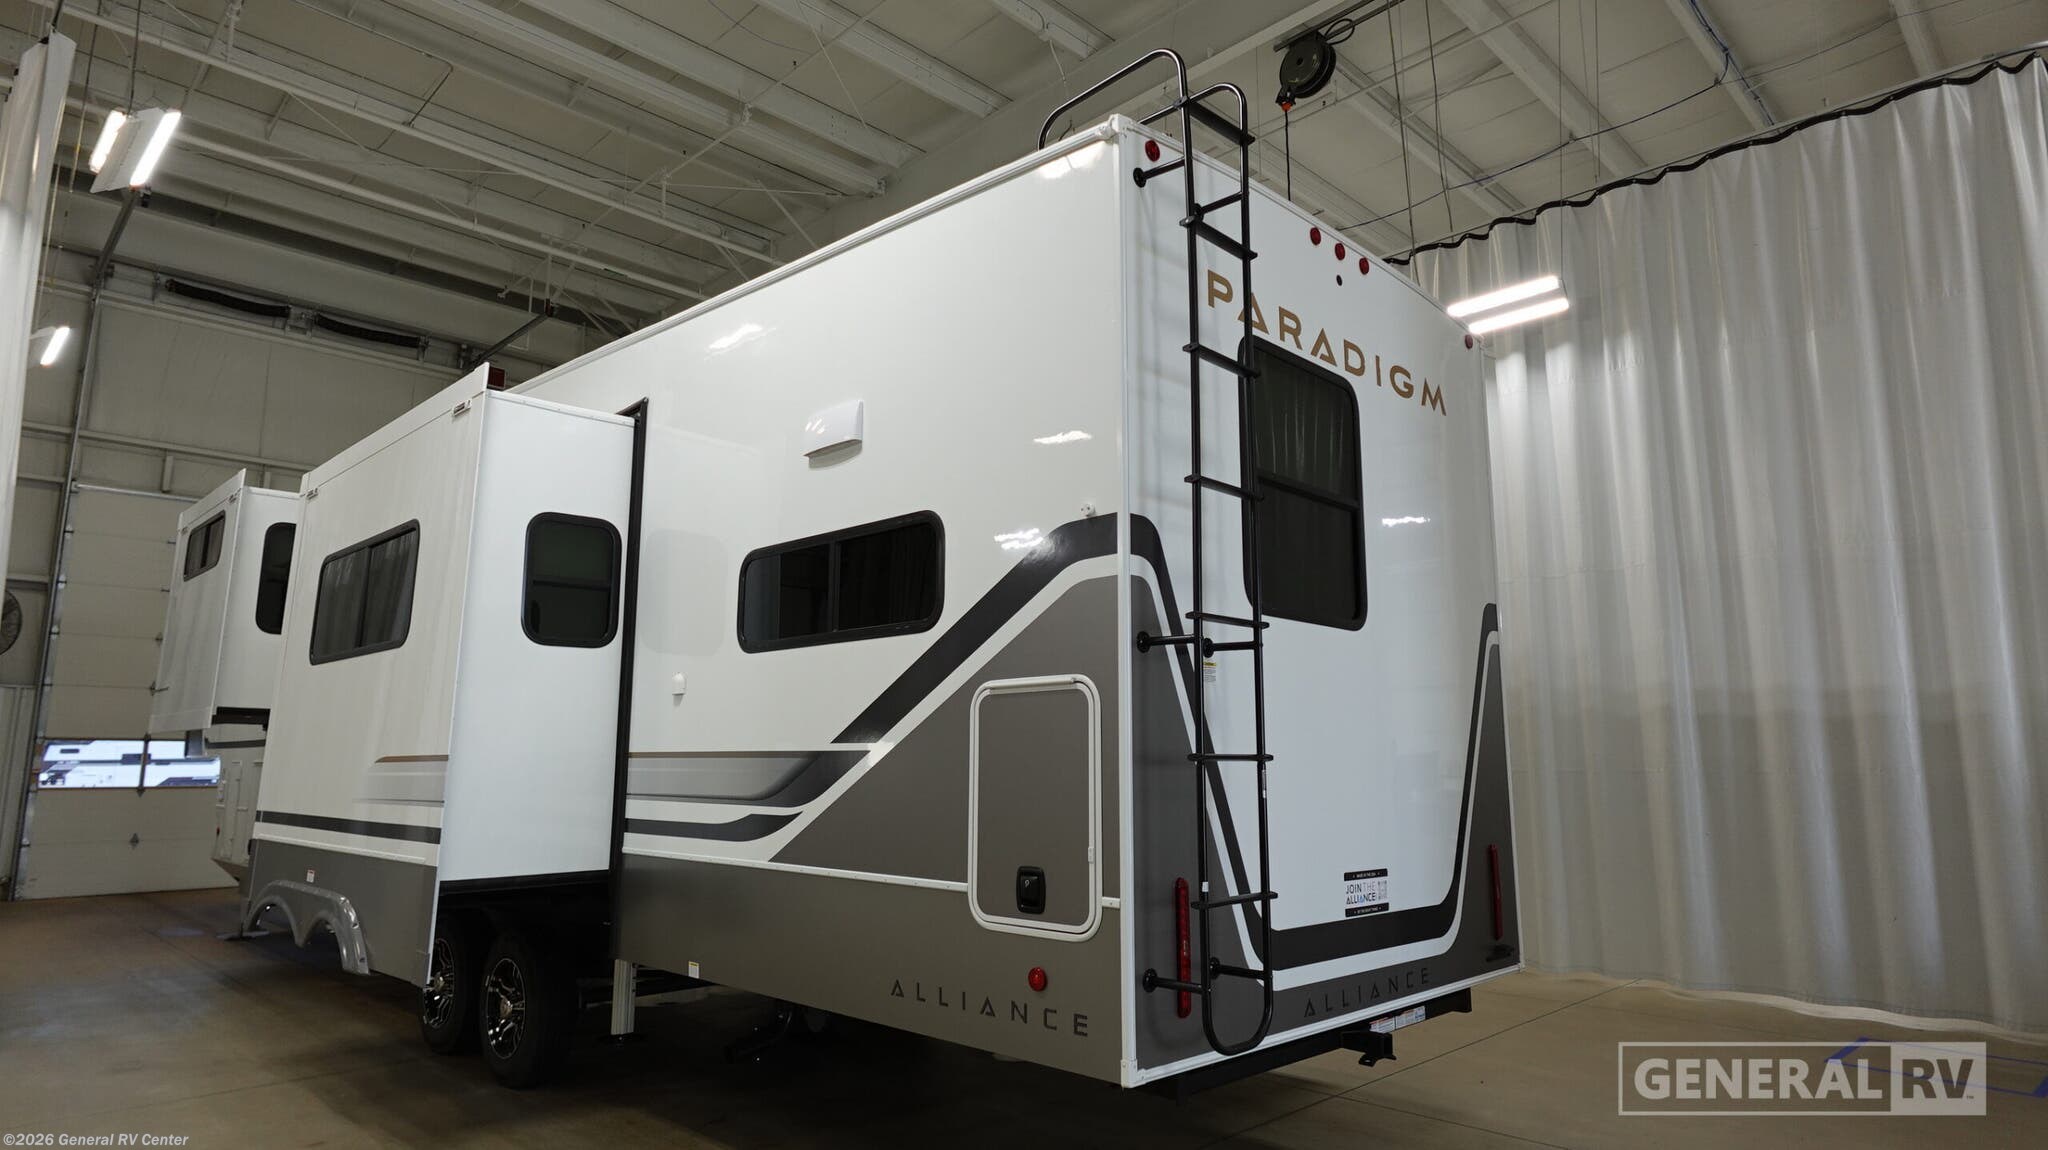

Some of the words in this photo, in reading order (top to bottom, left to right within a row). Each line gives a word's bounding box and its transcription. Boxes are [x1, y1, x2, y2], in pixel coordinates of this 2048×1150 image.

[1207, 269, 1447, 417] PARADIGM
[1346, 884, 1362, 894] JOIN
[1346, 893, 1376, 904] ALLIANCE
[890, 979, 1088, 1037] ALLIANCE
[1303, 967, 1430, 1018] ALLIANCE
